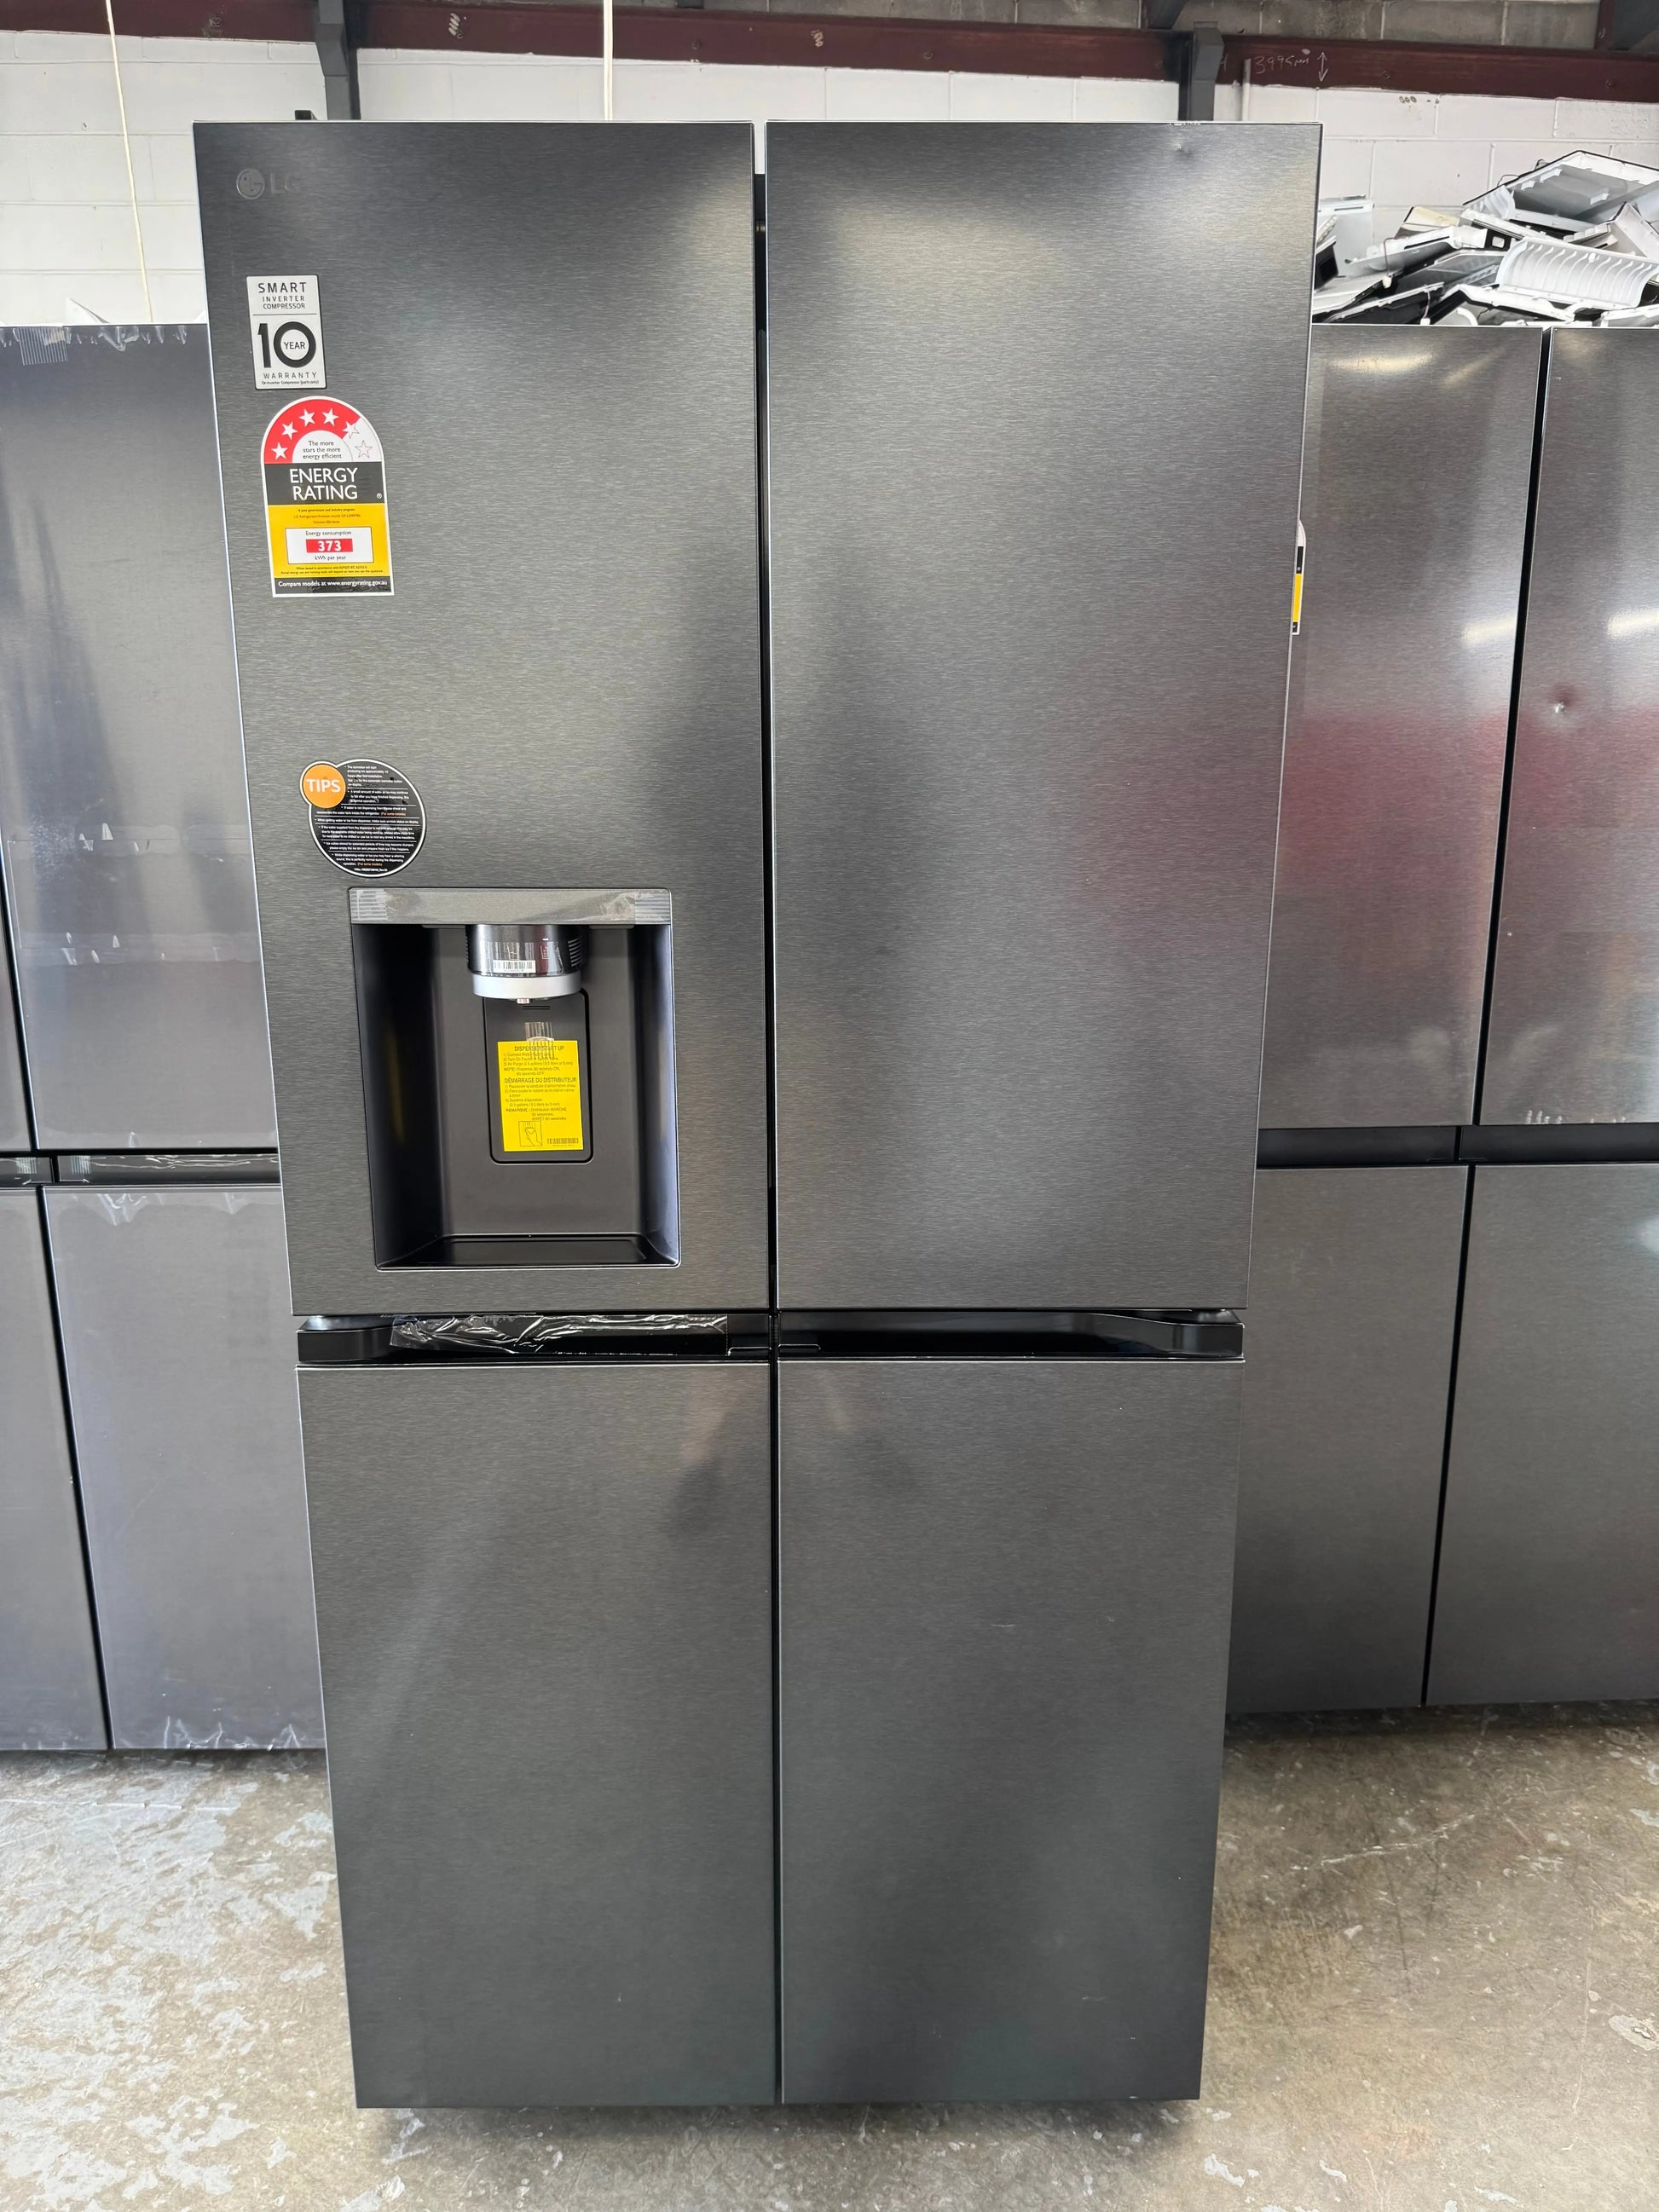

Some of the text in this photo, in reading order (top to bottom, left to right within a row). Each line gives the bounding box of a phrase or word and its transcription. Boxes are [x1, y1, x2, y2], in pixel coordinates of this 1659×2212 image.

[257, 281, 307, 293] SMART
[257, 321, 316, 368] 10
[283, 341, 306, 349] YEAR
[263, 371, 317, 379] WARRANTY
[289, 467, 358, 483] ENERGY
[293, 484, 358, 500] RATING
[317, 540, 342, 552] 373
[306, 778, 341, 793] TIPS
